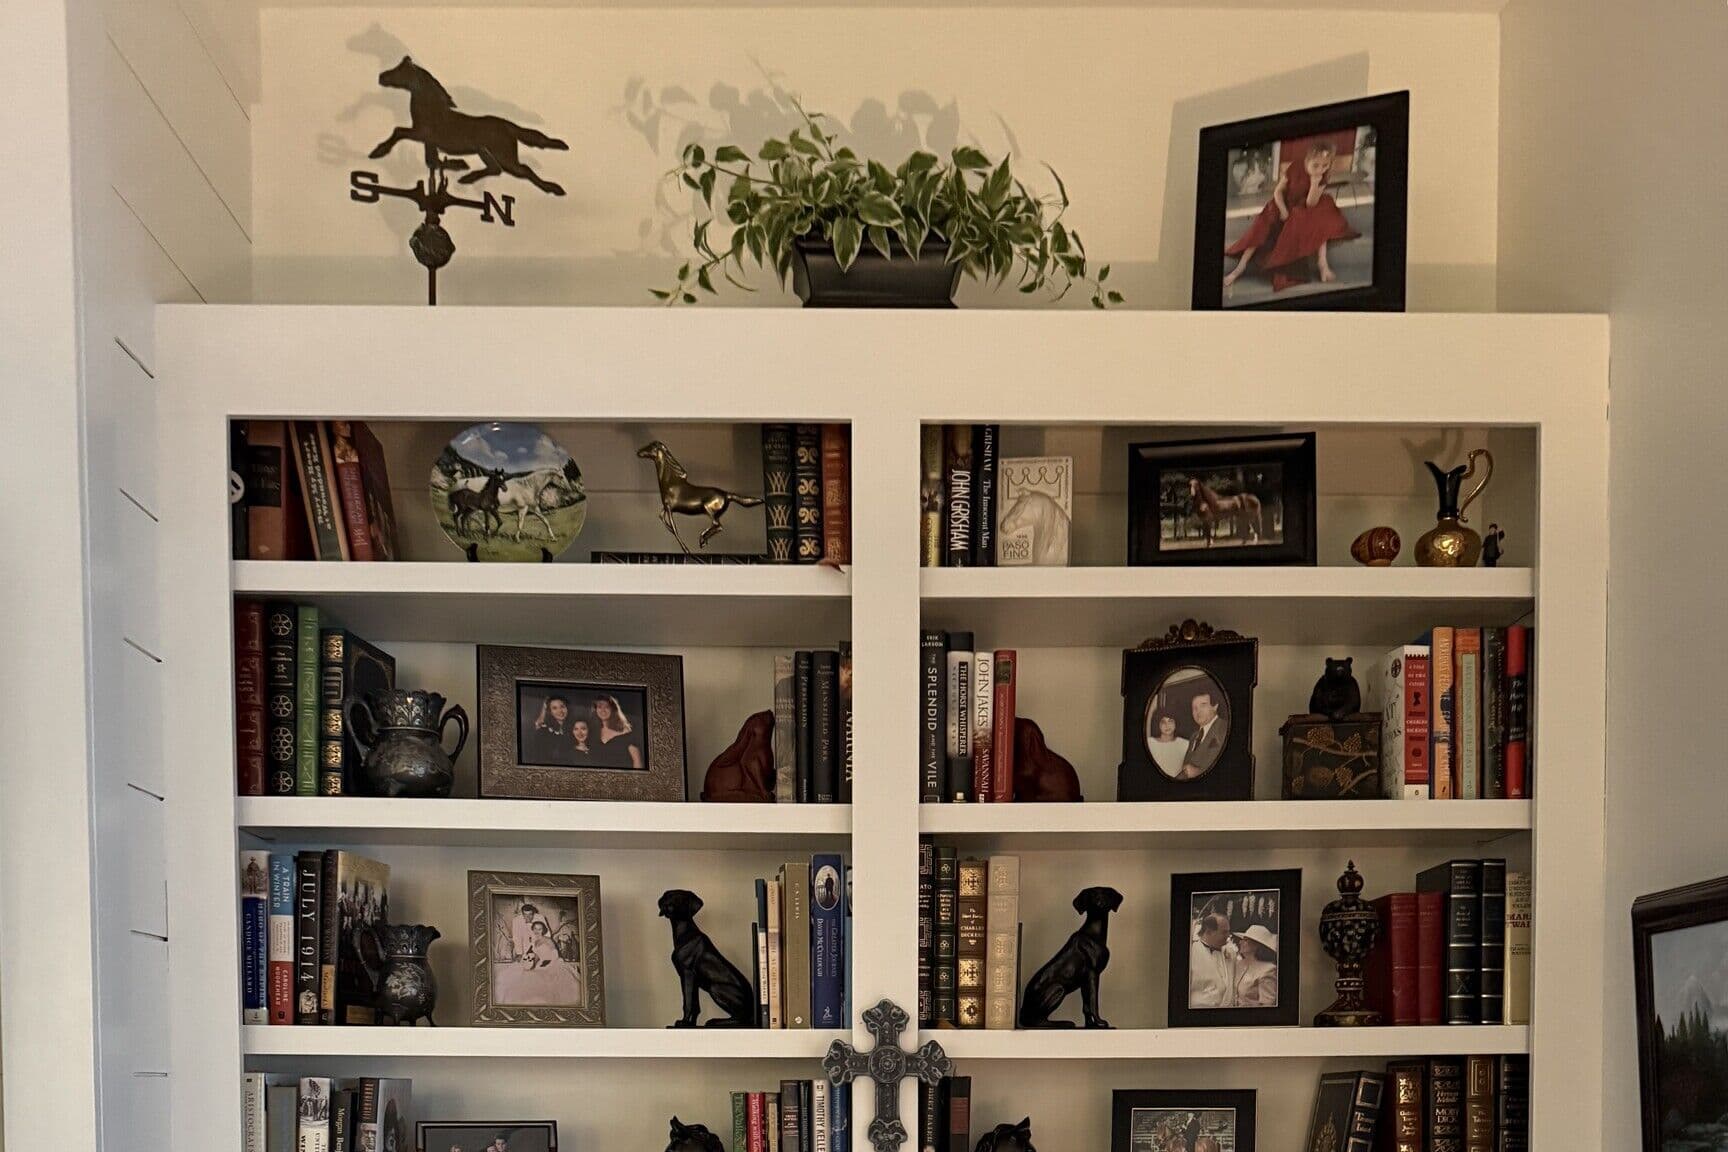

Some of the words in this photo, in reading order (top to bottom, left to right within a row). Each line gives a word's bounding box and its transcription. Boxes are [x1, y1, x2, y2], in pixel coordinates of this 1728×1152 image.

[350, 171, 379, 203] S
[481, 191, 515, 227] N
[983, 428, 992, 471] GRISHAM
[951, 469, 971, 499] JOHN
[982, 480, 991, 495] The
[950, 501, 970, 551] GRISHAM
[982, 496, 990, 530] Innocent
[981, 531, 990, 548] Man
[1003, 541, 1029, 549] PASO
[1003, 550, 1028, 560] FINO
[959, 665, 967, 681] THE
[977, 659, 989, 693] JOHN
[927, 667, 937, 731] SPLENDID
[959, 684, 967, 709] HORSE
[976, 695, 988, 727] JAKES
[959, 711, 967, 755] WHISPERER
[927, 761, 937, 788] VILE
[981, 748, 989, 793] SAVANNAH
[273, 861, 281, 871] IN
[273, 874, 281, 909] WINTER
[282, 877, 290, 903] TRAIN
[302, 869, 316, 923] JULY
[817, 918, 825, 936] DAVID
[300, 935, 315, 982] 1914
[336, 1108, 345, 1134] Morgan
[816, 1095, 825, 1127] TIMOTHY
